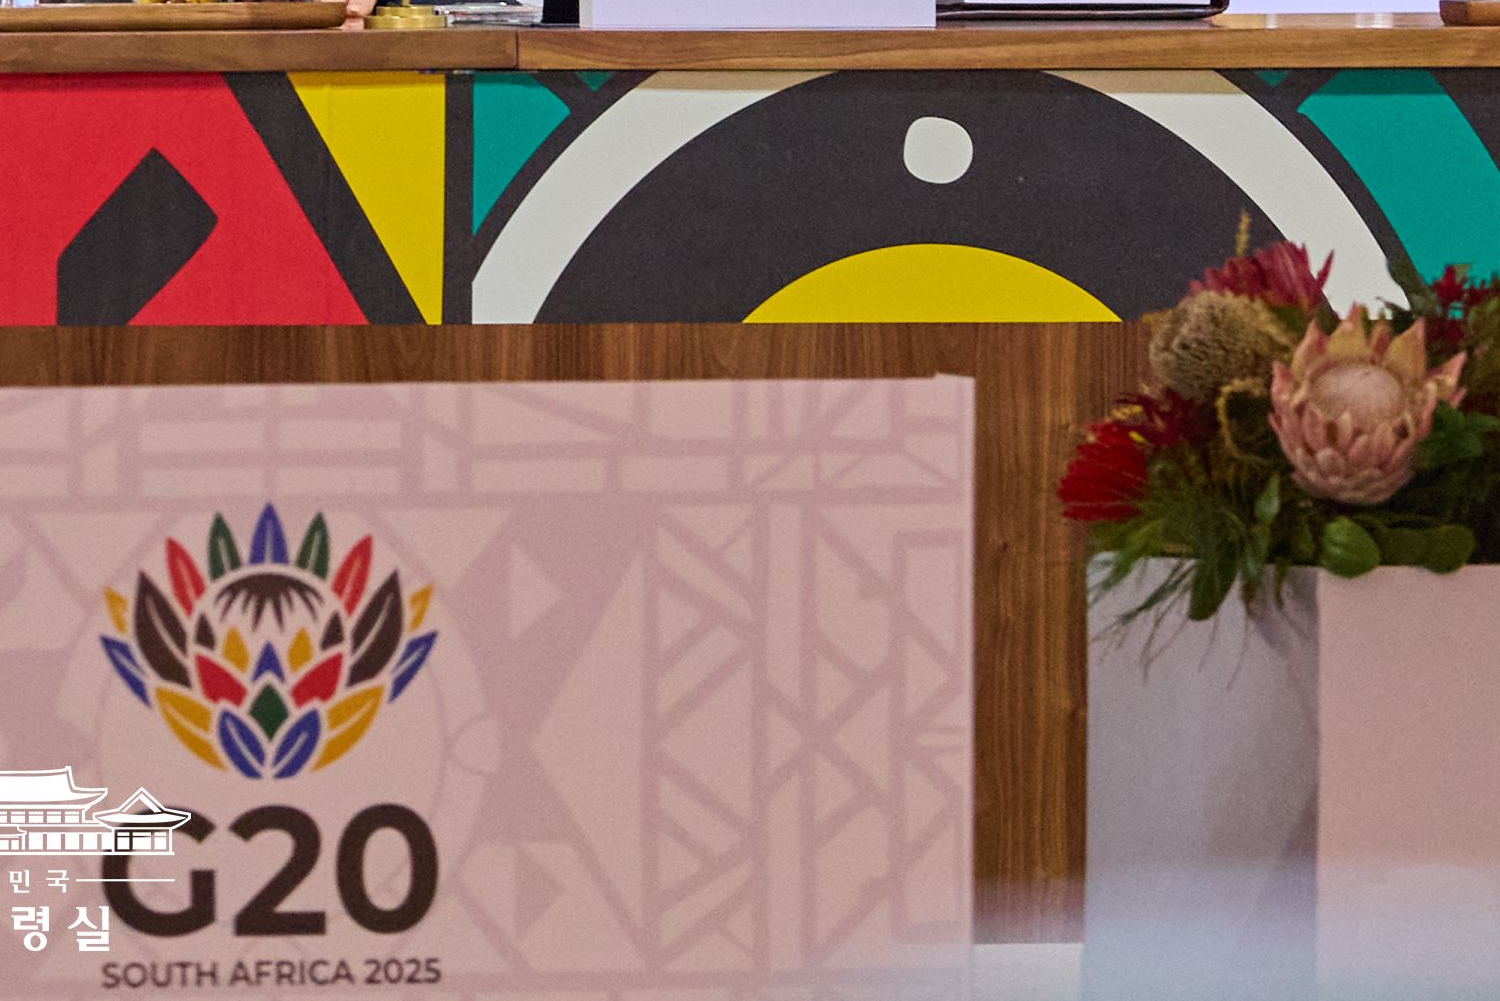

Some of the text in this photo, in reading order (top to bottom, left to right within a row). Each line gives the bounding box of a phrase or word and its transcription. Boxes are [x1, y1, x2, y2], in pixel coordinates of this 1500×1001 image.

[101, 803, 438, 937] G20
[101, 958, 442, 989] SOUTH AFRICA 2025
